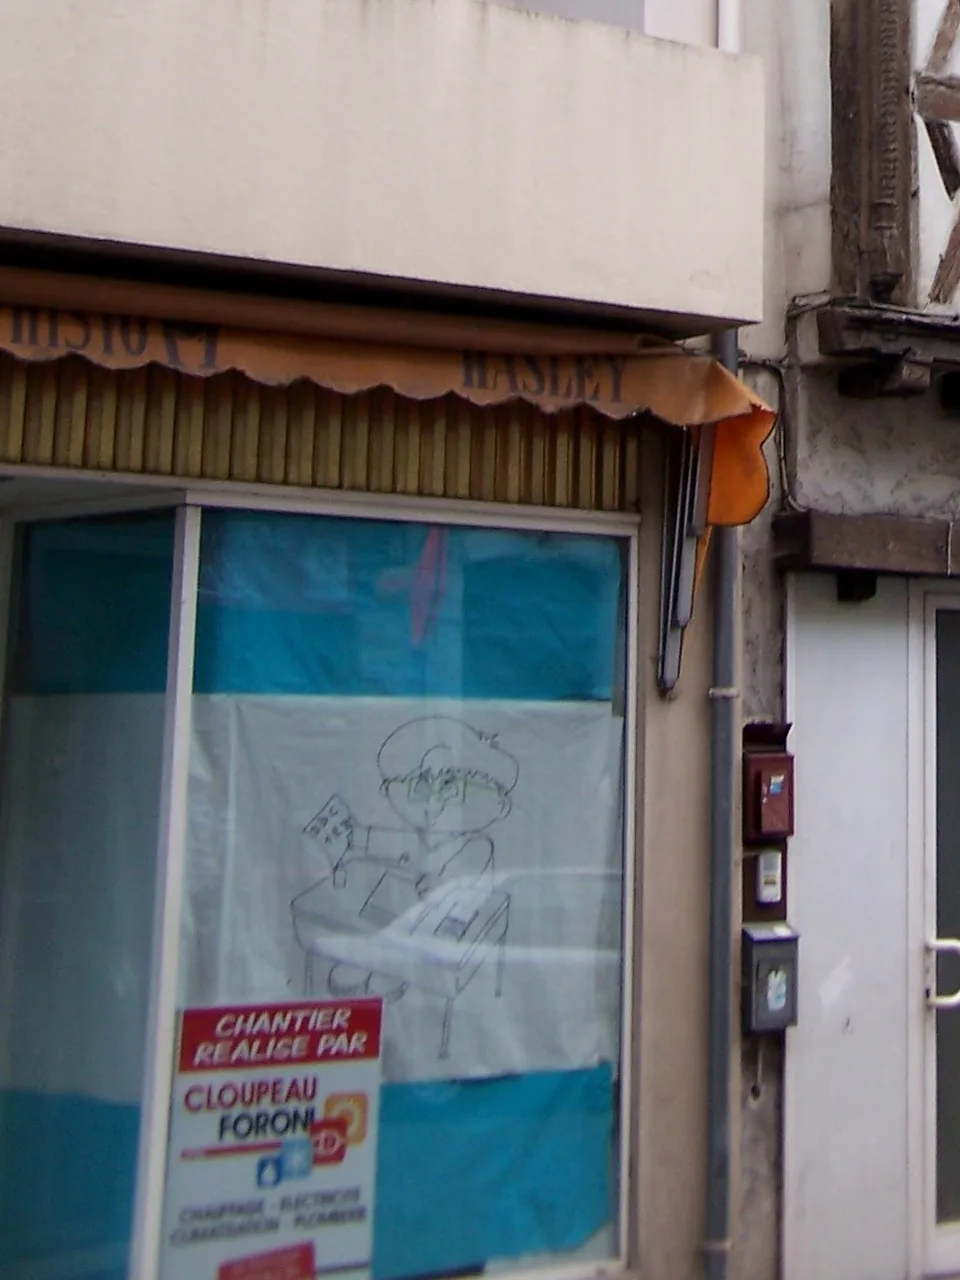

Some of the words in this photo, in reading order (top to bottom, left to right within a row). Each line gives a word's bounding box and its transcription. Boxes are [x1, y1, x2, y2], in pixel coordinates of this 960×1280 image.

[215, 1008, 352, 1037] CHANTIER
[193, 1035, 312, 1066] REALISE
[317, 1032, 368, 1056] PAR
[183, 1075, 318, 1112] CLOUPEAU
